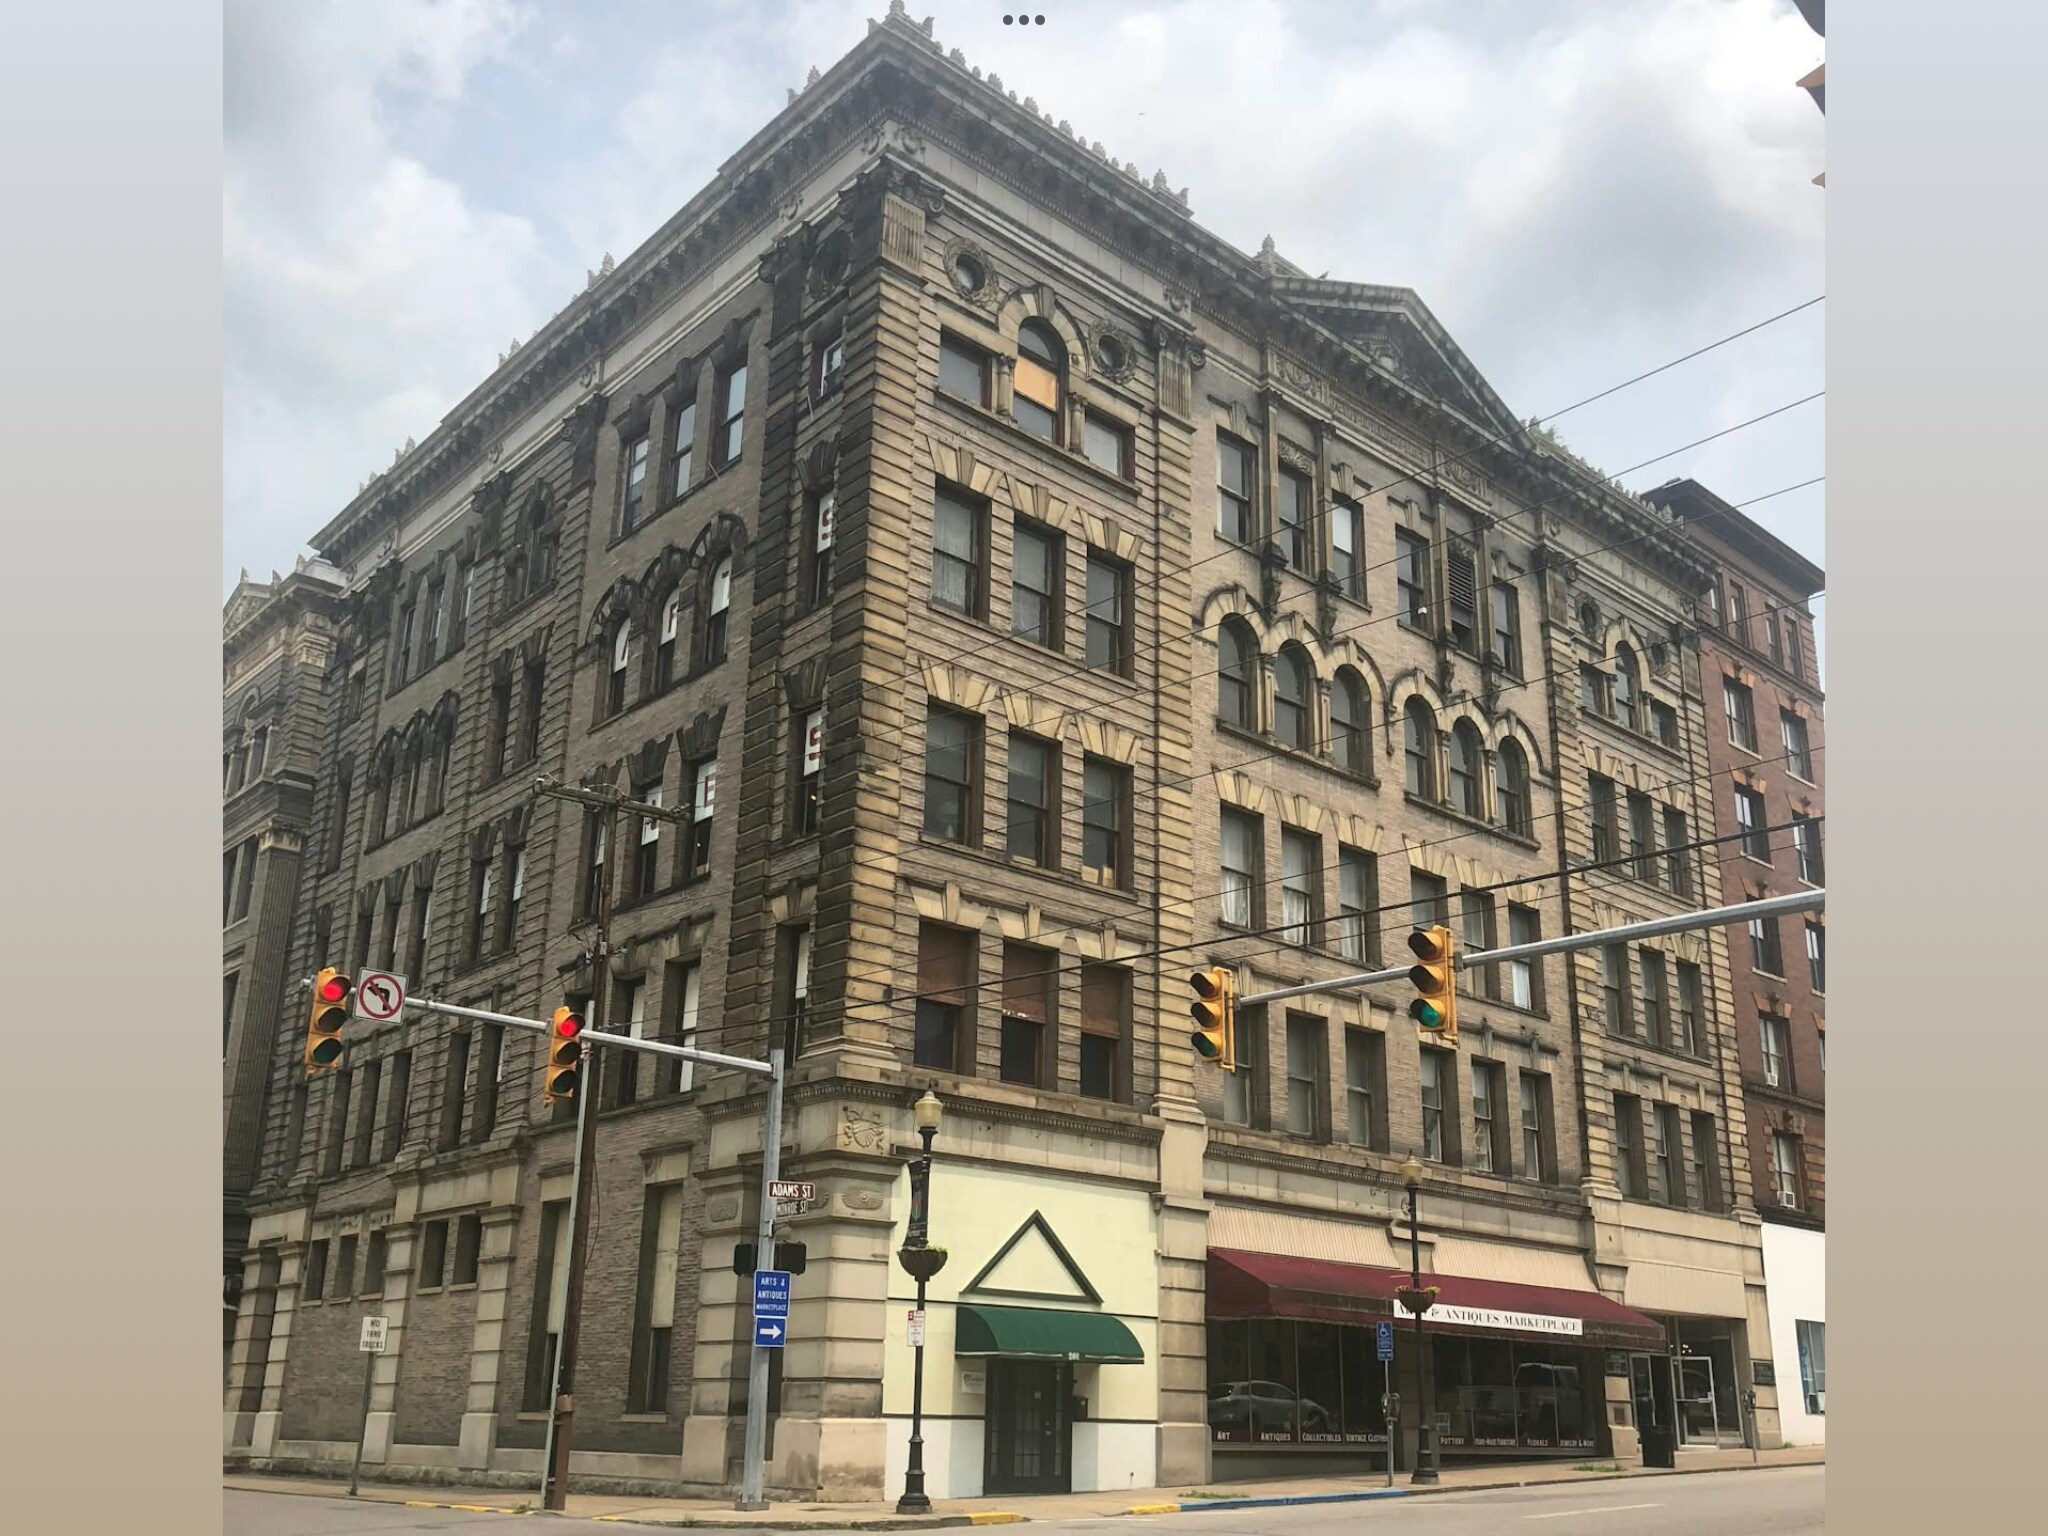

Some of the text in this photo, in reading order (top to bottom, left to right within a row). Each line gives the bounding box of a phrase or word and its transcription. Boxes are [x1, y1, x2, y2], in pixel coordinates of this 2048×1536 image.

[772, 1183, 811, 1199] ADAMS ST
[799, 1200, 807, 1213] ST
[760, 1277, 777, 1286] ARTS
[757, 1290, 787, 1299] ANTIQUES
[756, 1303, 787, 1311] MARKETPLACE
[370, 1319, 380, 1327] NO
[1445, 1309, 1500, 1324] ANTIQUES
[1504, 1316, 1579, 1332] MARKETPLACE
[1216, 1431, 1231, 1441] ART
[1260, 1433, 1291, 1443] ANTIQUES
[1302, 1432, 1342, 1443] COLLECTIBLES
[1440, 1436, 1465, 1445] POTTERY
